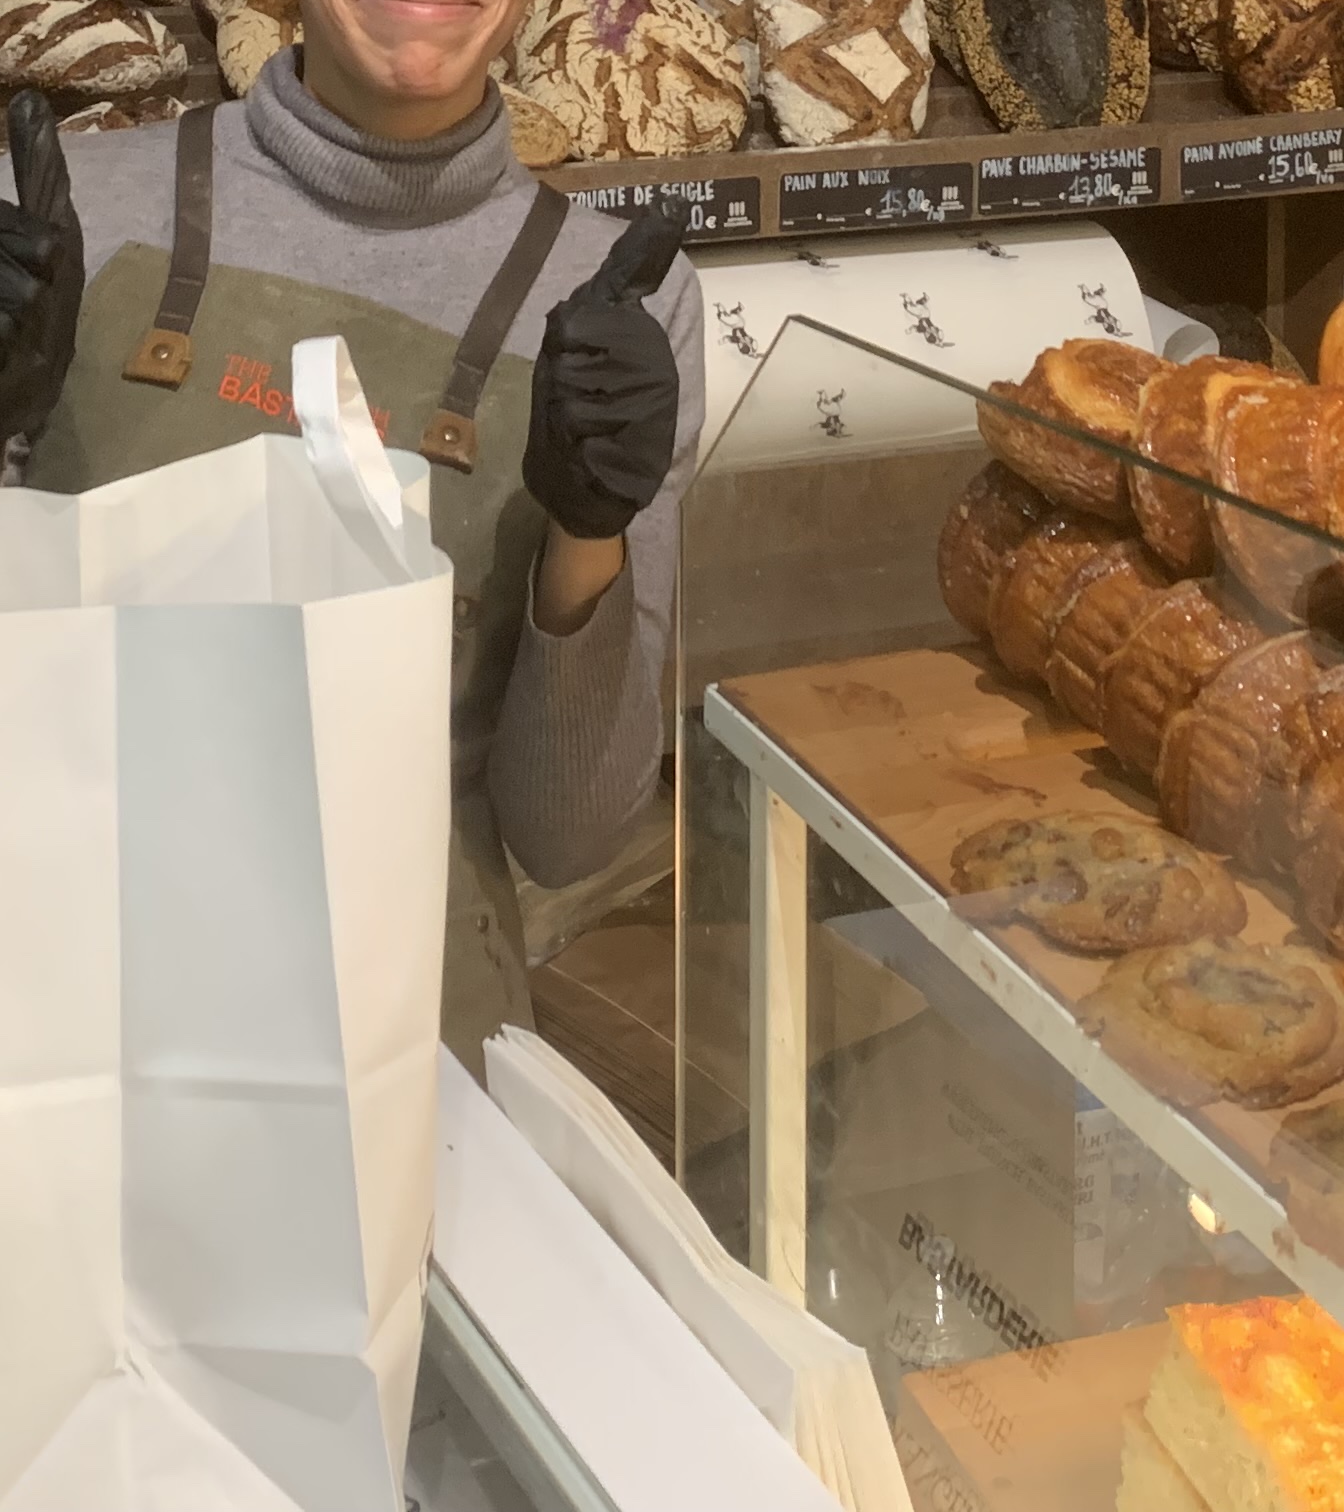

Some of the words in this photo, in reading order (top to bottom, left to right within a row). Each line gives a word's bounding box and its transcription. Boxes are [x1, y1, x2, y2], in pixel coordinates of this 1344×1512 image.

[1184, 143, 1215, 164] PAIN
[1218, 135, 1264, 160] AVOINE
[1269, 128, 1343, 152] CRANBERRY
[784, 173, 817, 192] PAIN
[821, 171, 850, 189] AUX
[857, 168, 891, 186] NOIX
[218, 375, 293, 416] BAS
